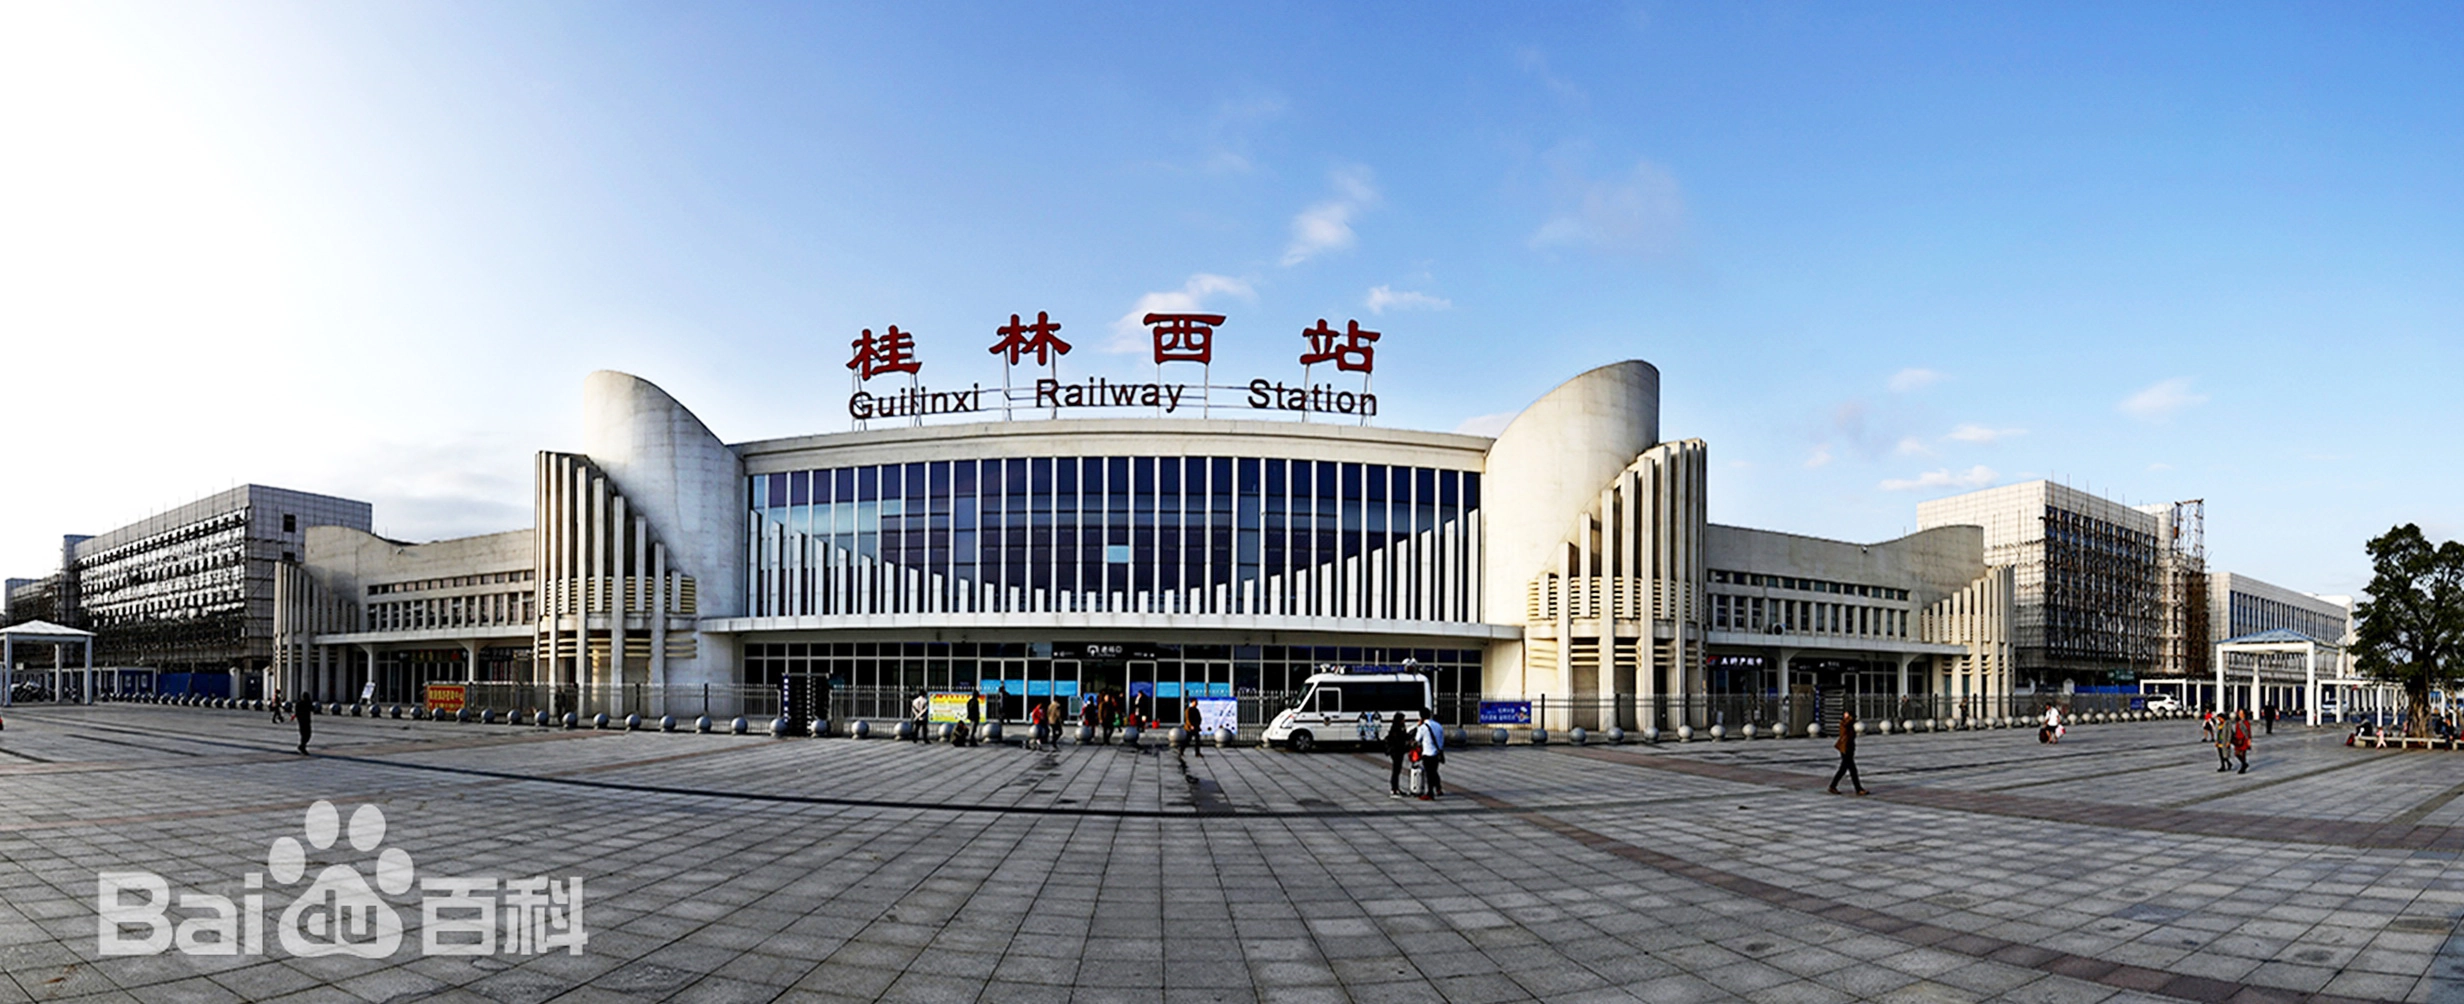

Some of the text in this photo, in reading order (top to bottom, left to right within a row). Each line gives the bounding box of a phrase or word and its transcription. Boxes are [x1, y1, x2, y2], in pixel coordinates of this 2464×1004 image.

[846, 311, 1381, 381] 桂林西站
[849, 377, 1377, 419] Guilinxi Railway Station
